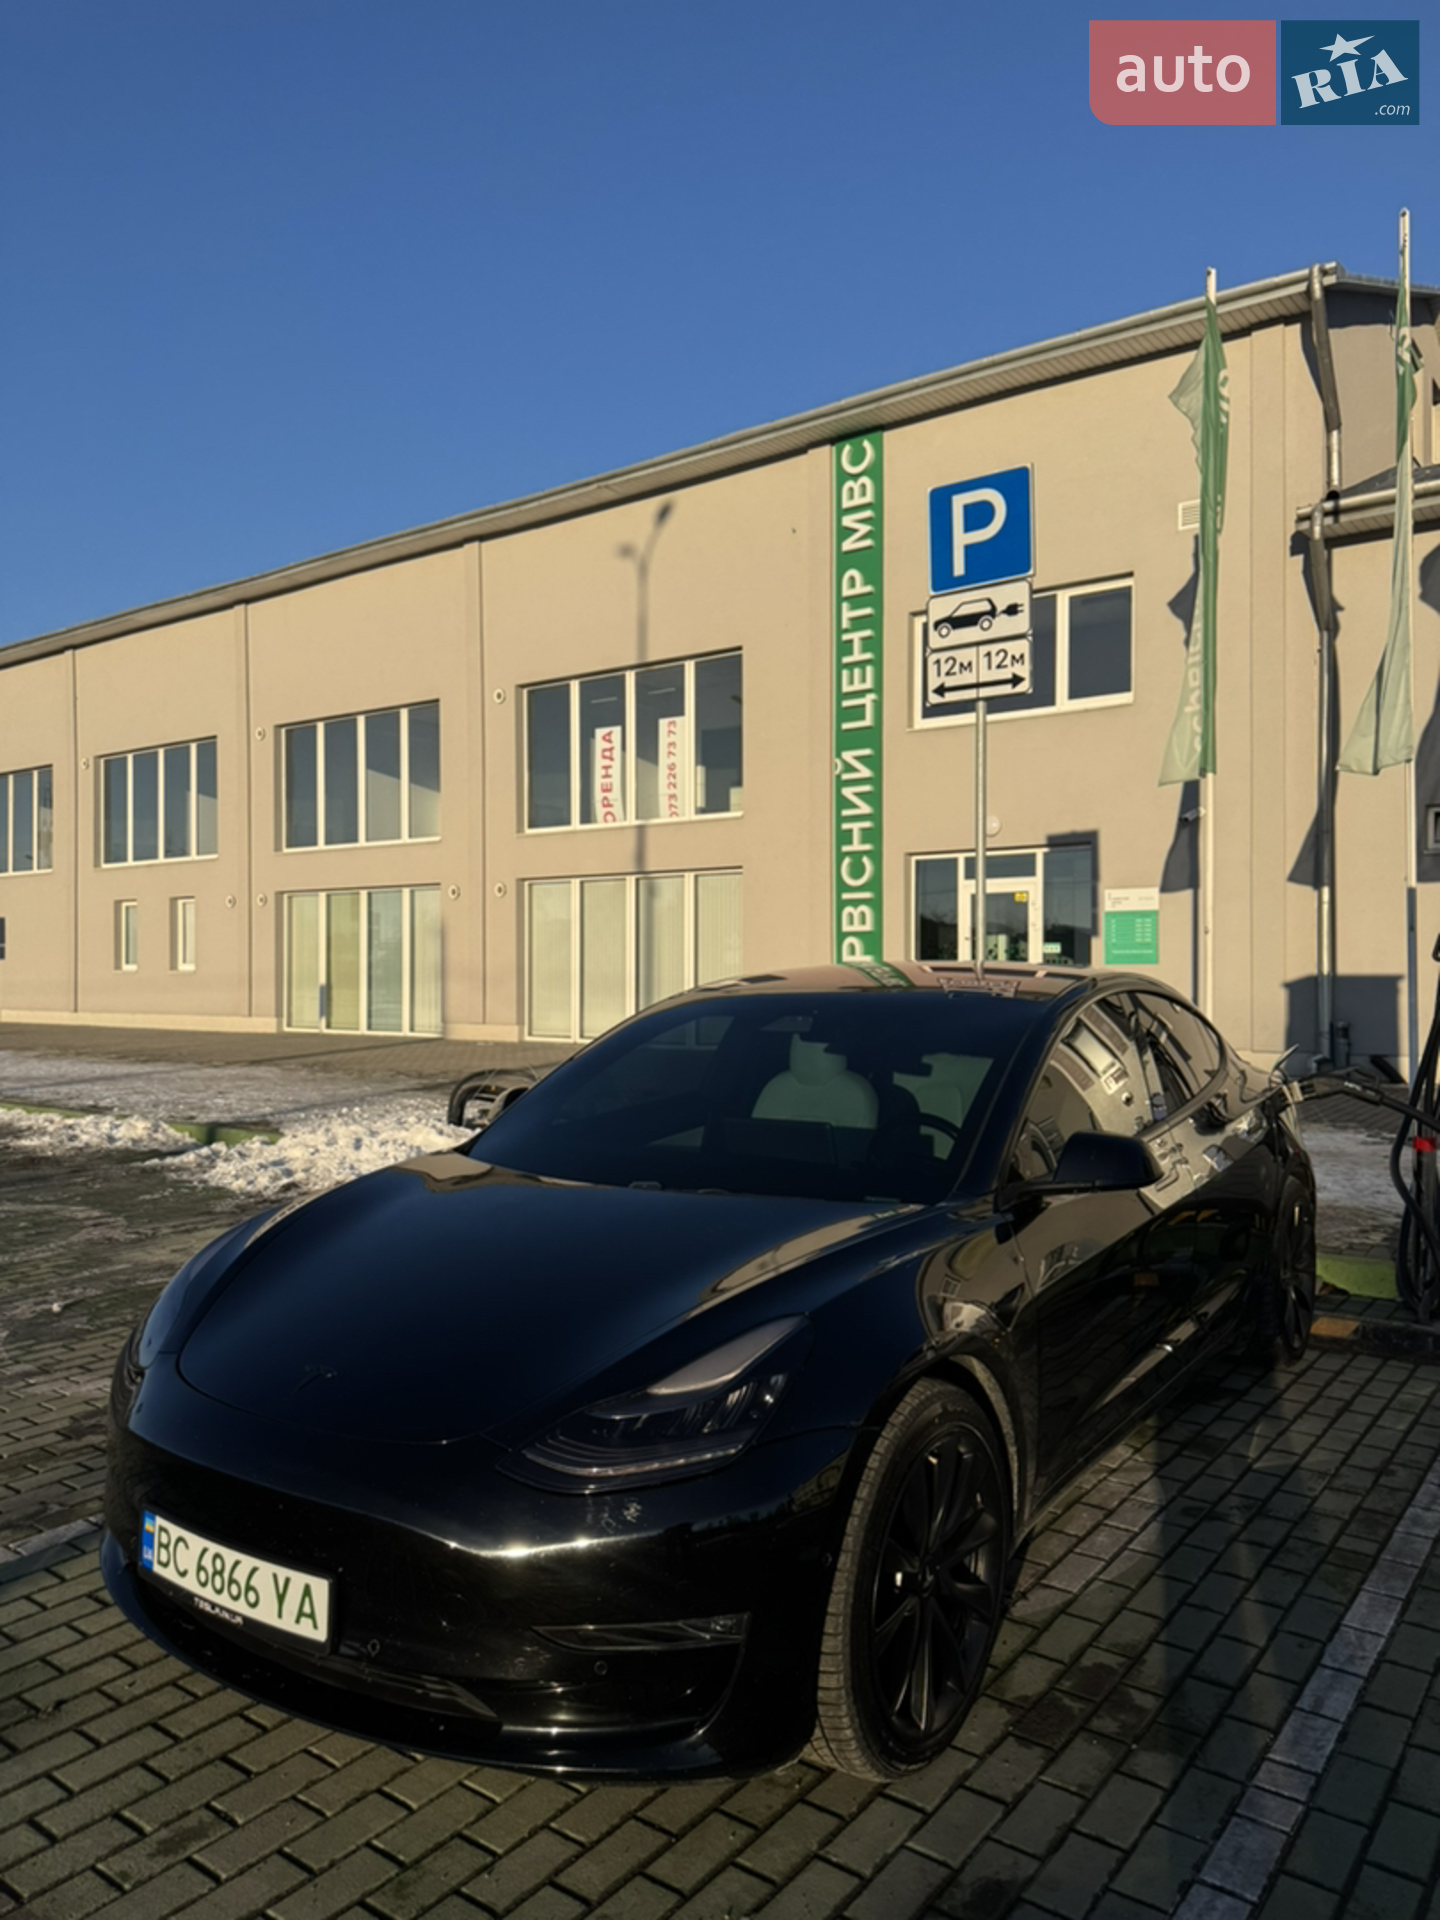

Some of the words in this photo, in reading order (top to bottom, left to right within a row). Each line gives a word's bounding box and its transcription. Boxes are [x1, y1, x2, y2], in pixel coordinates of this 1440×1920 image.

[840, 439, 876, 553] МВС
[951, 487, 1007, 578] P
[841, 567, 878, 730] ЦЕНТР
[667, 720, 677, 738] 73
[667, 741, 677, 759] 73
[667, 762, 677, 790] 226
[157, 1524, 190, 1579] BC
[196, 1546, 260, 1610] 6866
[272, 1571, 319, 1631] YA
